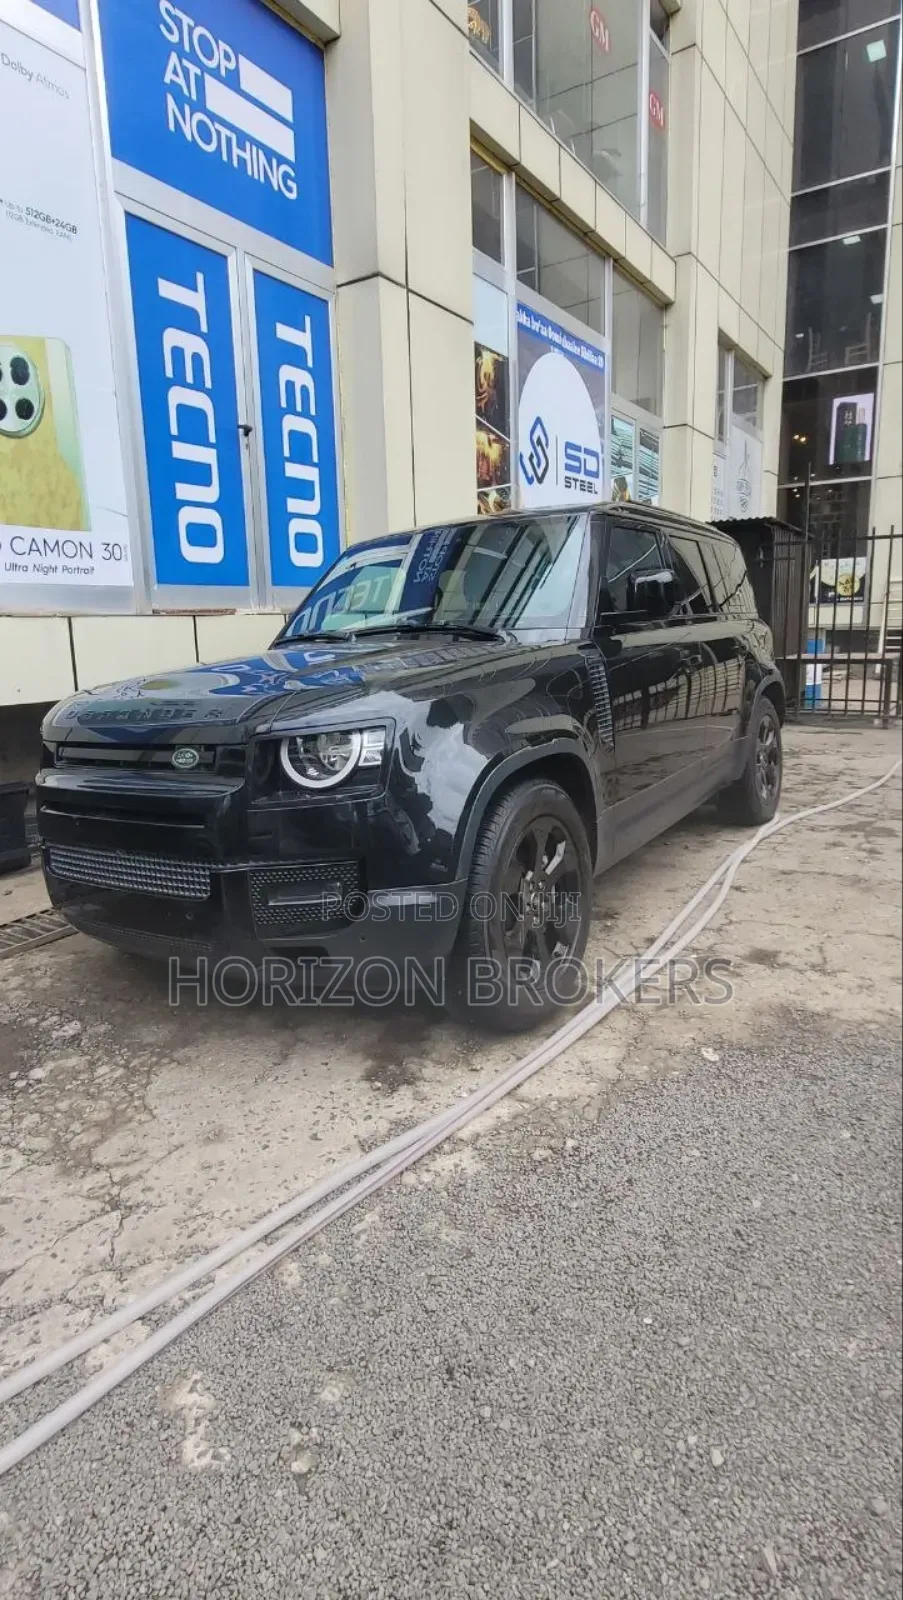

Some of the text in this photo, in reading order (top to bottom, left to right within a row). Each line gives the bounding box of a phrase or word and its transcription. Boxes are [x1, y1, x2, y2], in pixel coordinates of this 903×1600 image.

[159, 0, 236, 76] STOP
[590, 10, 609, 52] GM
[1, 52, 70, 99] Dolby Atmos
[164, 51, 201, 101] AT
[649, 93, 664, 127] GM
[166, 92, 297, 200] NOTHING
[157, 271, 225, 564] TECNO
[275, 315, 324, 568] TECNO
[565, 441, 599, 479] SD
[564, 476, 598, 494] STEEL
[4, 562, 95, 575] Ultra Night Portrait
[10, 536, 93, 559] CAMON
[101, 542, 122, 561] 30
